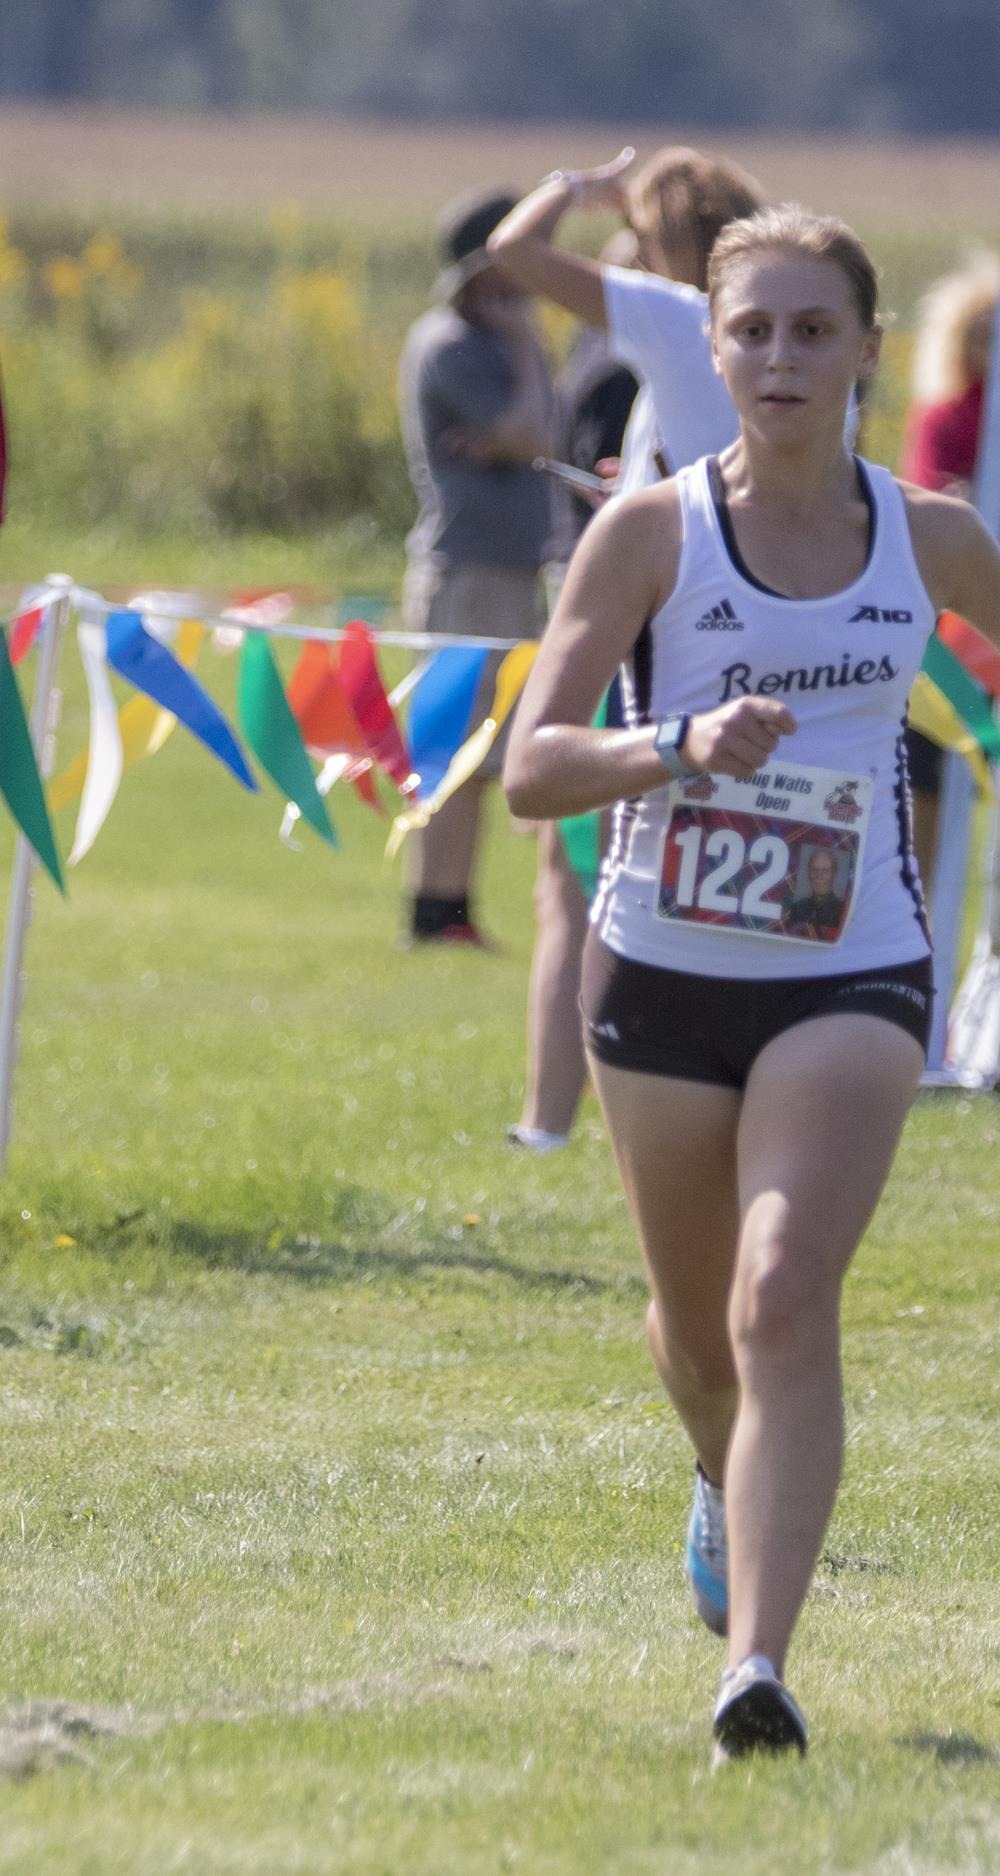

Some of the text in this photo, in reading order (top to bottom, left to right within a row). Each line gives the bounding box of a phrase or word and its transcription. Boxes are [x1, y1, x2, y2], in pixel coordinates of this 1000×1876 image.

[848, 605, 912, 624] A10
[696, 619, 744, 631] adidas
[719, 653, 899, 702] Bonnies
[774, 774, 814, 794] Watts
[755, 792, 791, 812] Open
[675, 825, 790, 920] 122
